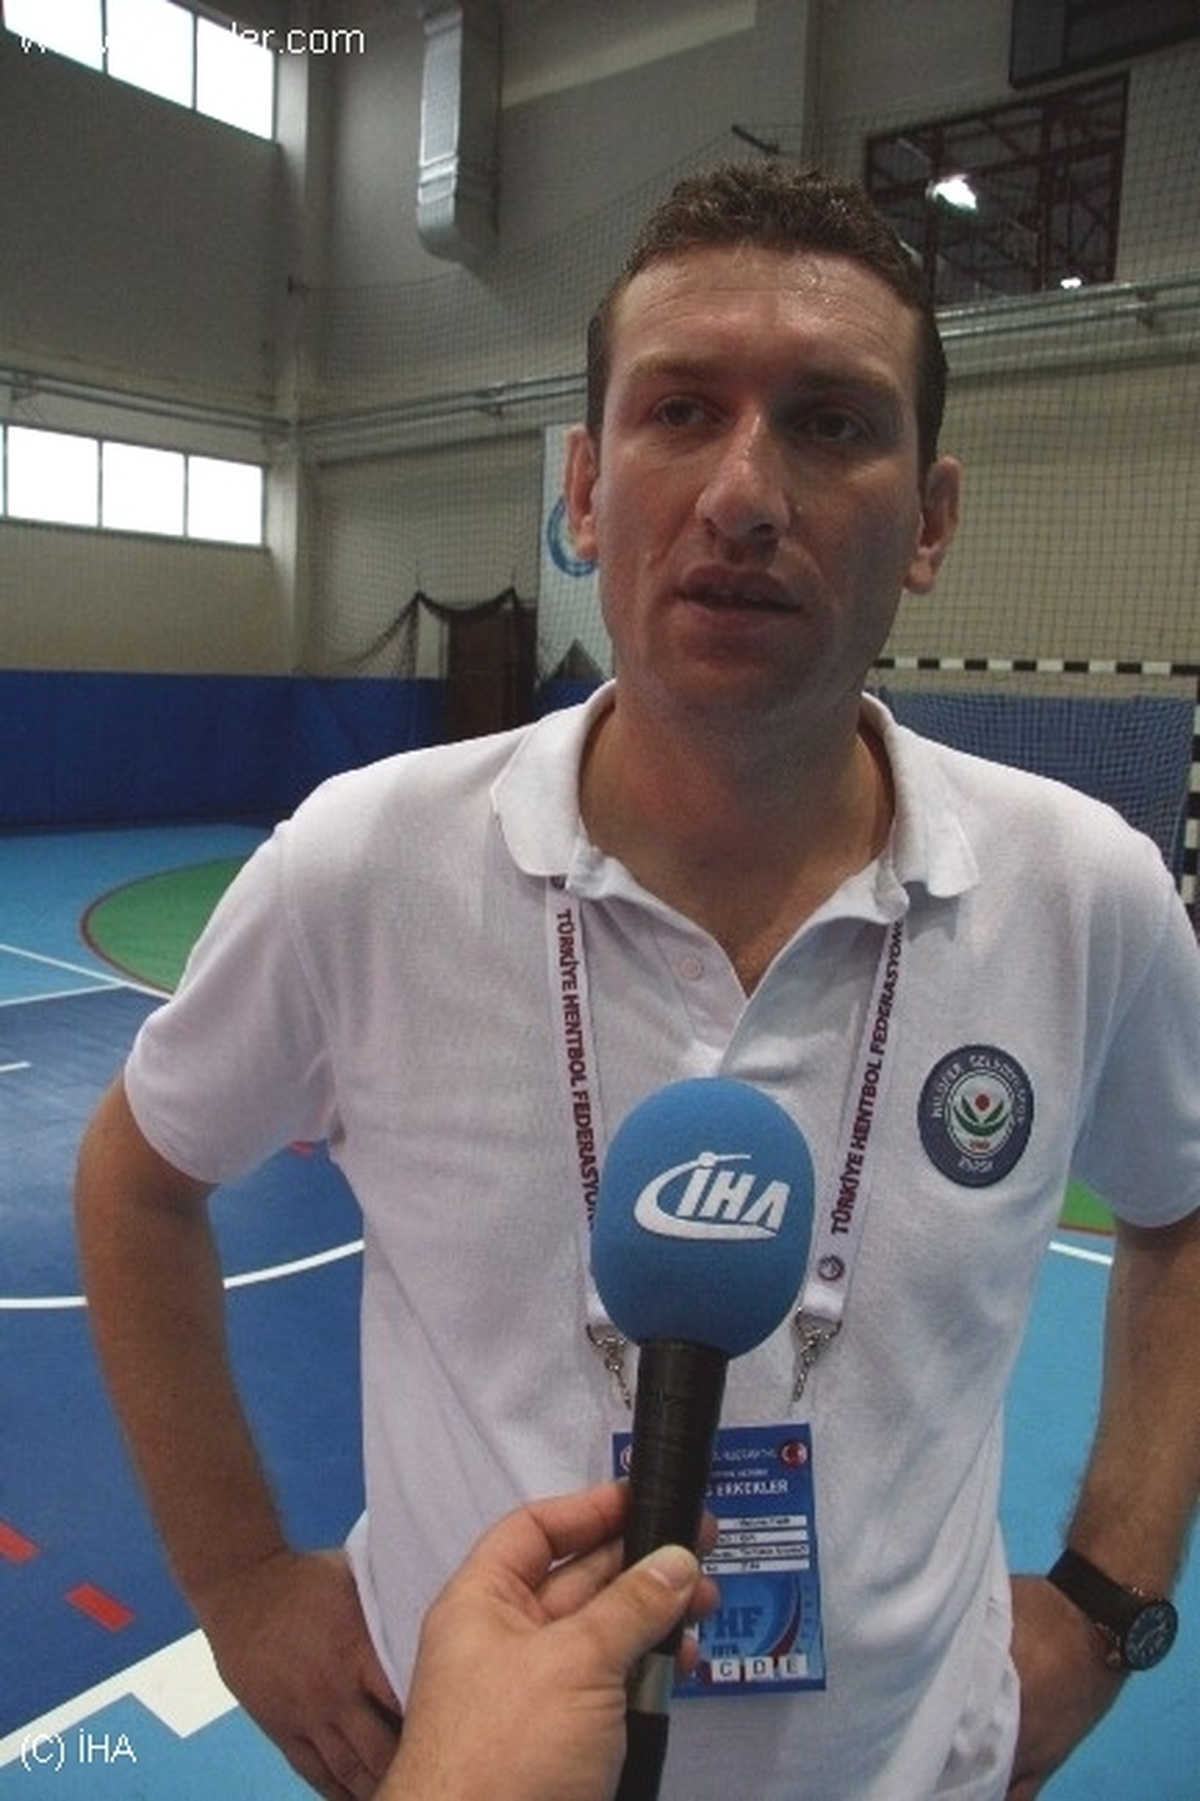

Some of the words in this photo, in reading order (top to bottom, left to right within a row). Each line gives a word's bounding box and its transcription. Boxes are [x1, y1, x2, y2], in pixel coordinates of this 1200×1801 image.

[556, 908, 580, 992] TÜRKİYE
[562, 992, 587, 1087] HENTBOL
[572, 1090, 600, 1232] FEDERASYO
[675, 1152, 791, 1233] İHA
[830, 1151, 865, 1235] TÜRKİYE
[850, 1058, 883, 1151] HENTBOL
